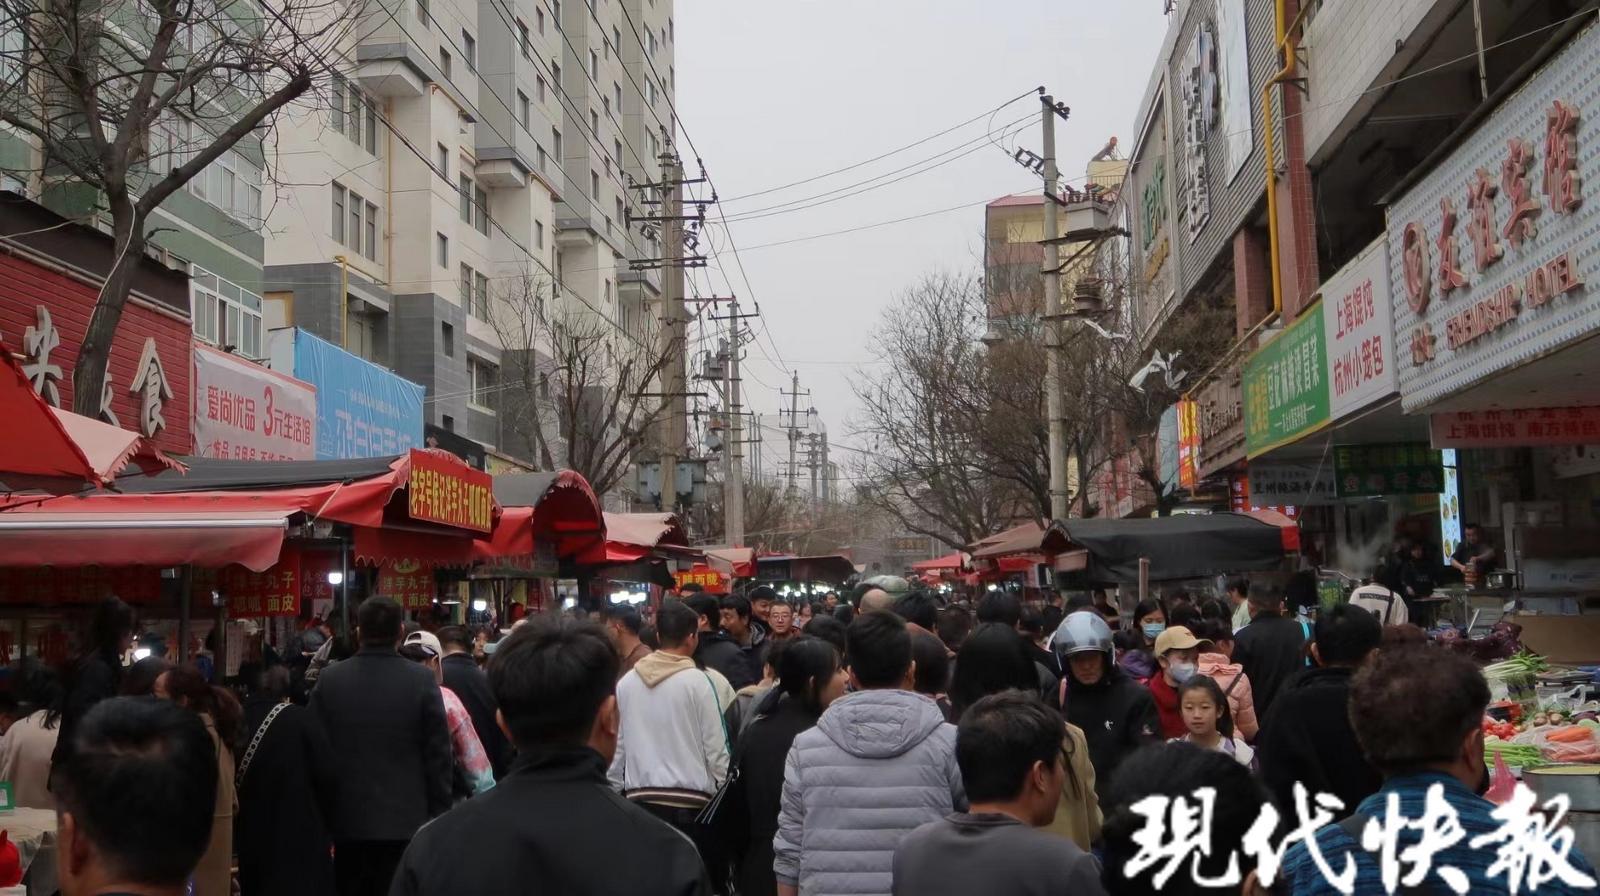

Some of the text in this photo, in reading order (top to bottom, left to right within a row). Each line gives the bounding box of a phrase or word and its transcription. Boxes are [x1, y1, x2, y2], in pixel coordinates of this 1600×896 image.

[1437, 99, 1582, 299] 友谊宾馆
[1336, 278, 1374, 339] 上海馄饨
[1446, 251, 1586, 350] FRIENDSHIP HOTEL
[1334, 335, 1384, 397] 杭州小笼包
[207, 385, 256, 432] 爱尚优品
[263, 385, 311, 446] 3元生活馆
[266, 592, 295, 612] 面皮
[408, 592, 430, 607] 面皮
